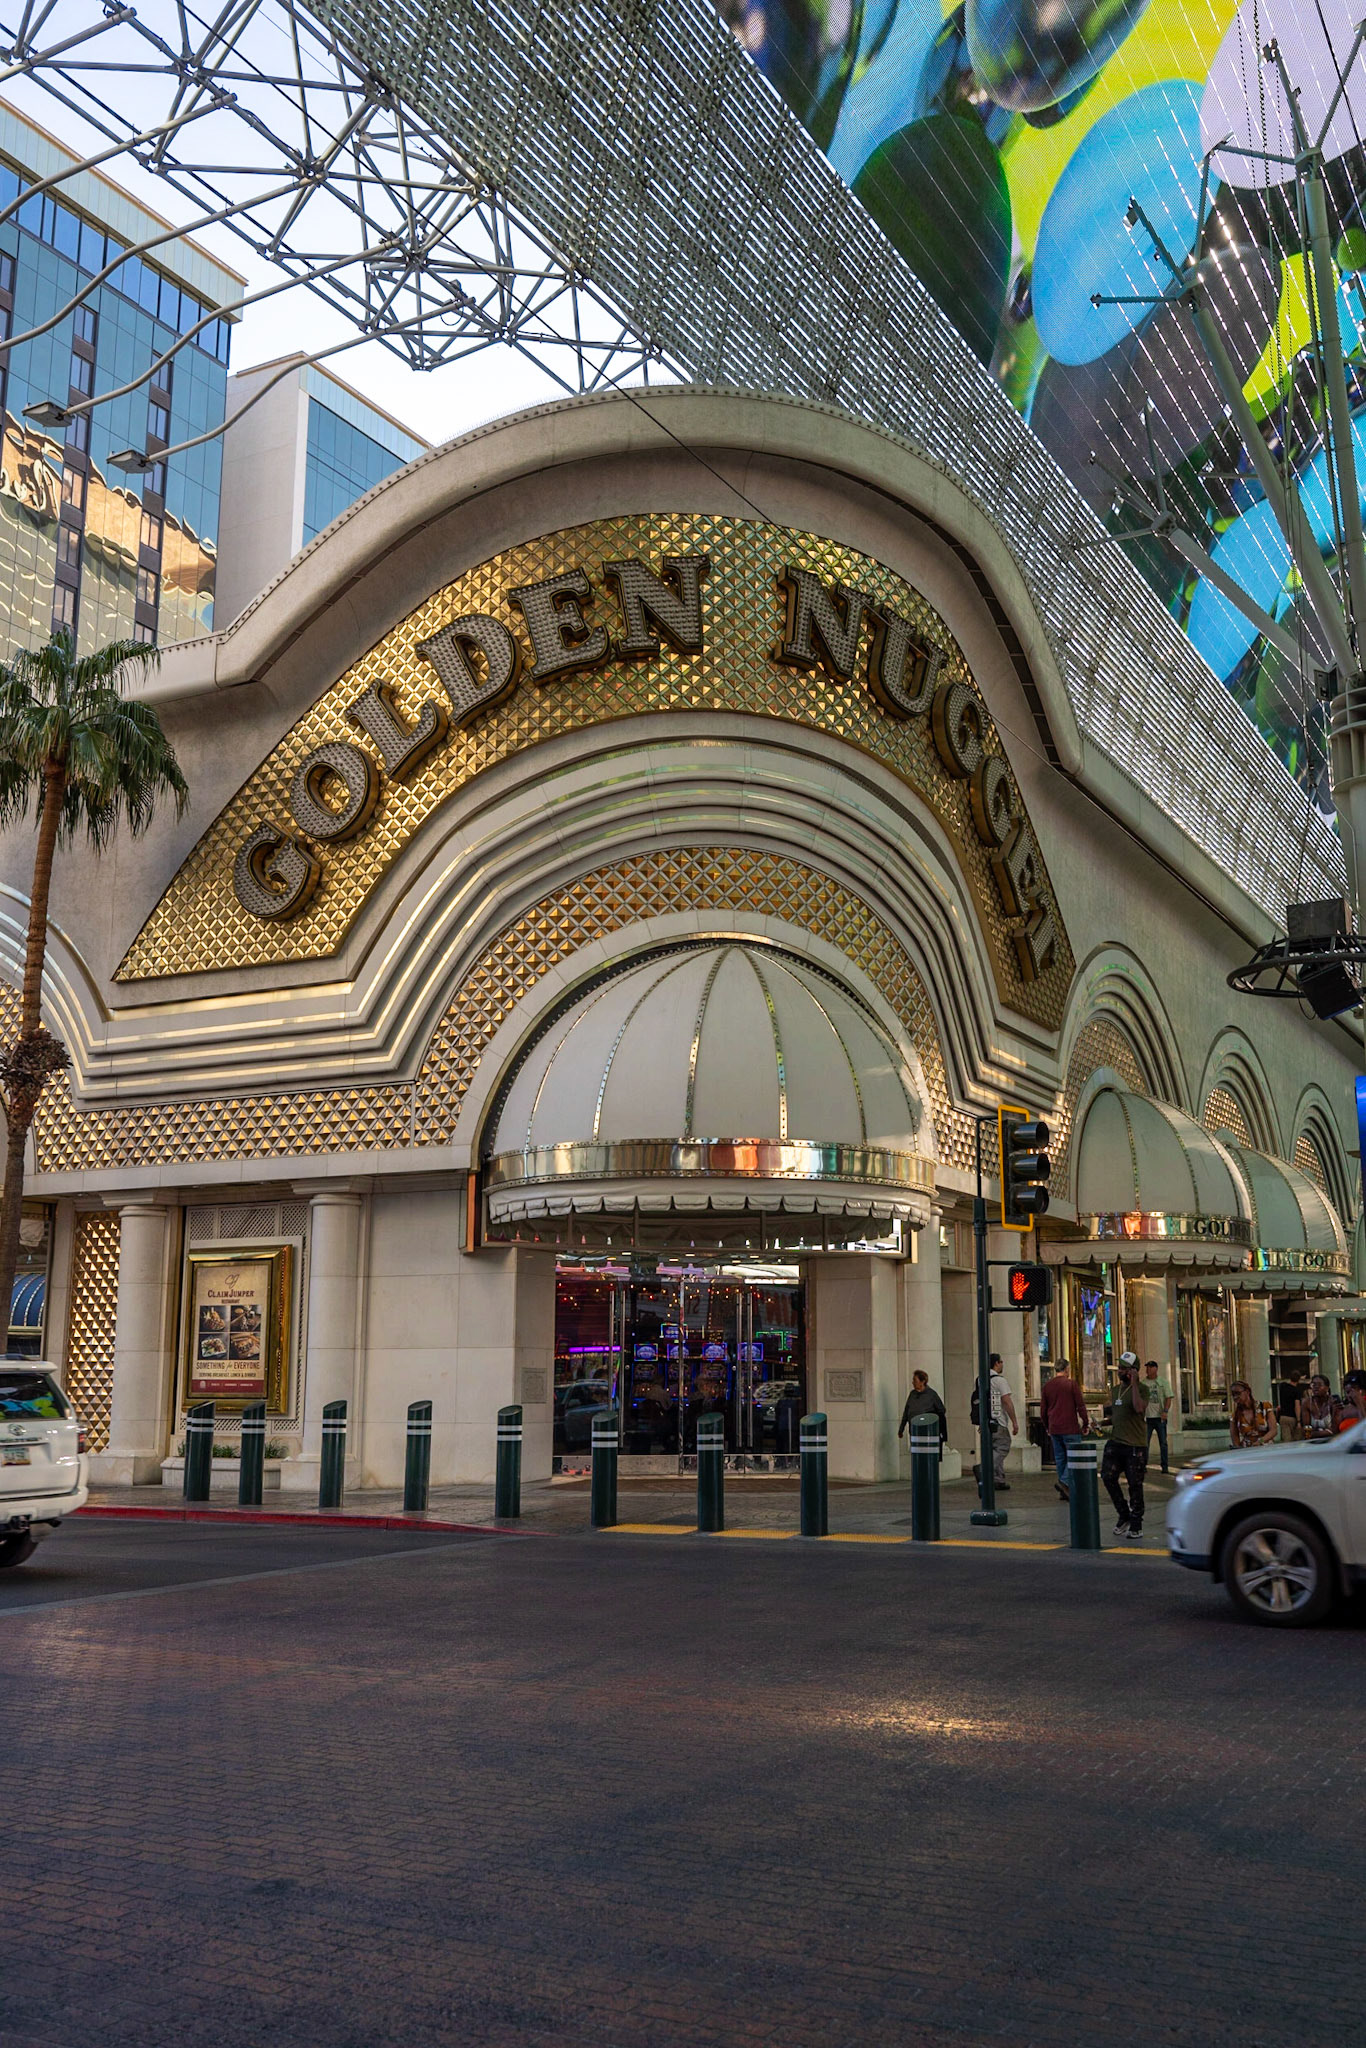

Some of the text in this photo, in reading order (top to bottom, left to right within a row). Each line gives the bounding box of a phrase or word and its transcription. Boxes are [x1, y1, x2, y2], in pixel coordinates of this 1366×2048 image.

[233, 554, 1059, 982] GOLDEN NUGGET
[229, 1288, 255, 1298] JUMPER
[196, 1361, 225, 1370] SOMETHING
[233, 1361, 260, 1370] EVERYONE
